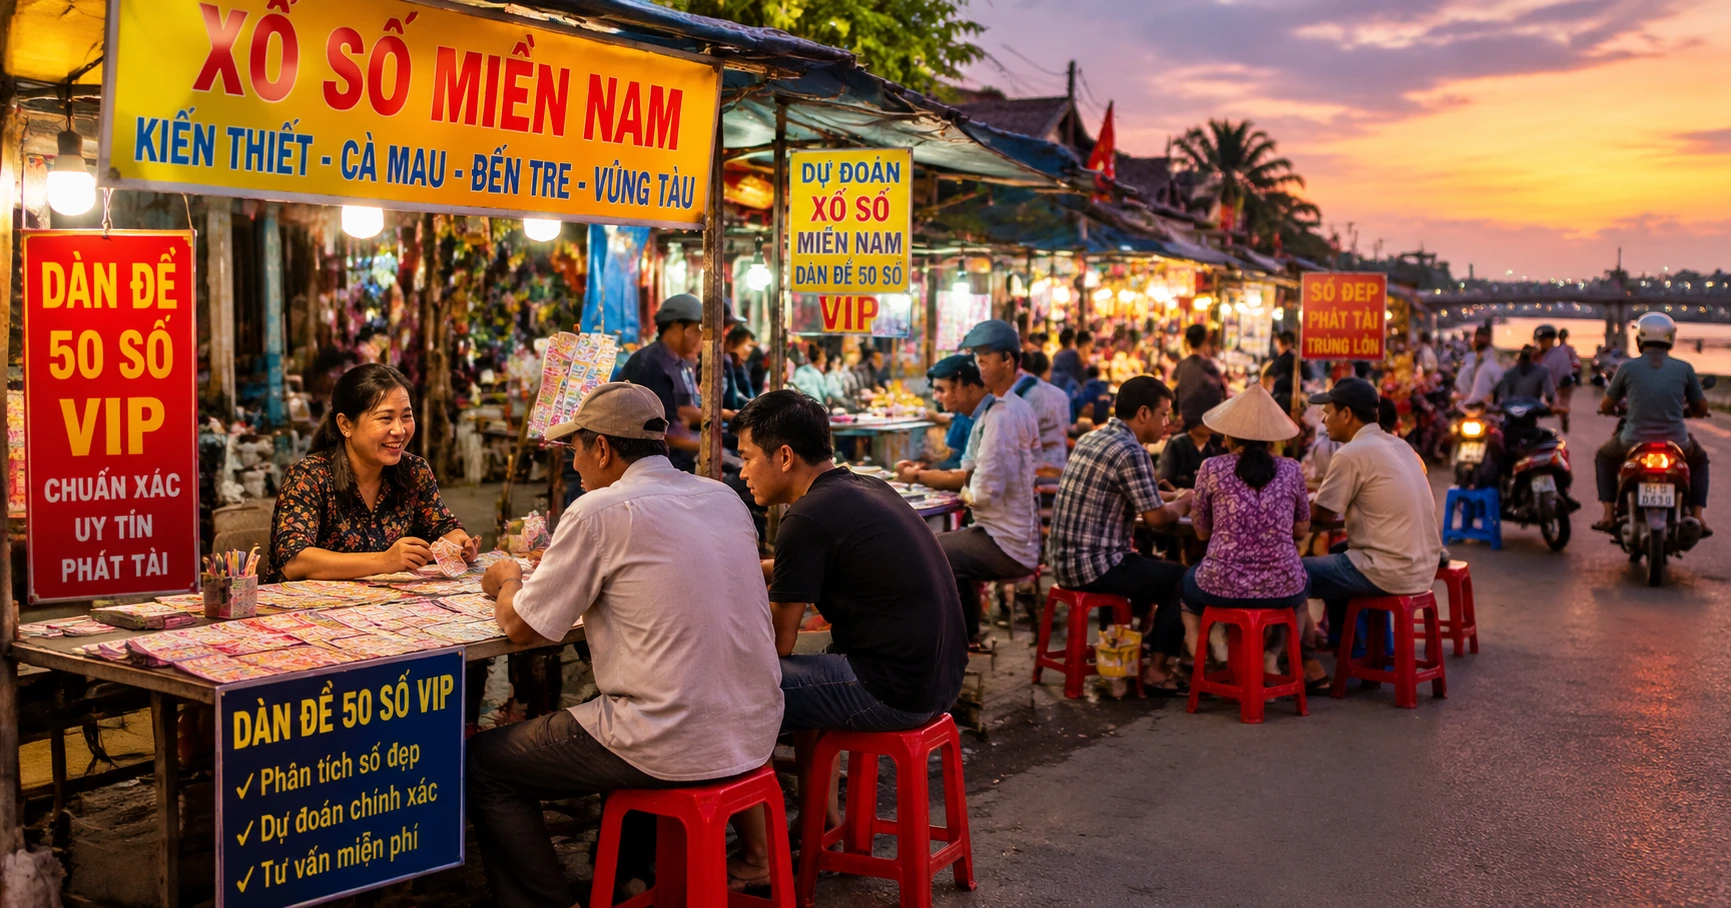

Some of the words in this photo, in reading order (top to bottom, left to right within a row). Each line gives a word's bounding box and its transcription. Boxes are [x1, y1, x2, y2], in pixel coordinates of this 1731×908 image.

[322, 10, 419, 117] SỐ
[430, 34, 570, 137] MIỀN
[583, 73, 683, 151] NAM
[134, 106, 216, 167] KIẾN
[226, 118, 314, 176] THIẾT
[341, 131, 378, 182] CÀ
[387, 144, 446, 188] MAU
[529, 159, 572, 199] TRE
[658, 165, 696, 209] TÀU
[811, 187, 848, 222] XỐ
[855, 187, 890, 222] SỐ
[855, 232, 902, 254] NAM
[42, 250, 117, 309] DÀN
[858, 265, 877, 285] 50
[1310, 276, 1336, 302] SỐ
[818, 295, 879, 331] VIP
[49, 329, 104, 380] 50
[119, 314, 174, 380] SỐ
[59, 396, 166, 457] VIP
[134, 467, 180, 498] XÁC
[75, 516, 107, 542] UY
[114, 508, 153, 539] TÍN
[62, 549, 124, 583] PHÁT
[131, 547, 168, 577] TÀI
[233, 697, 291, 750] DÀN
[300, 680, 334, 737] ĐỀ
[343, 688, 373, 728] 50
[379, 669, 411, 721] SỐ
[417, 674, 454, 714] VIP
[261, 762, 311, 796] Phân
[317, 751, 352, 784] tích
[359, 741, 381, 775] số
[387, 742, 420, 771] đẹp
[261, 811, 290, 844] Dự
[295, 799, 344, 834] đoán
[350, 784, 401, 820] chính
[407, 777, 438, 807] xác
[261, 858, 288, 888] Tư
[294, 845, 330, 880] vấn
[390, 822, 418, 862] phí
